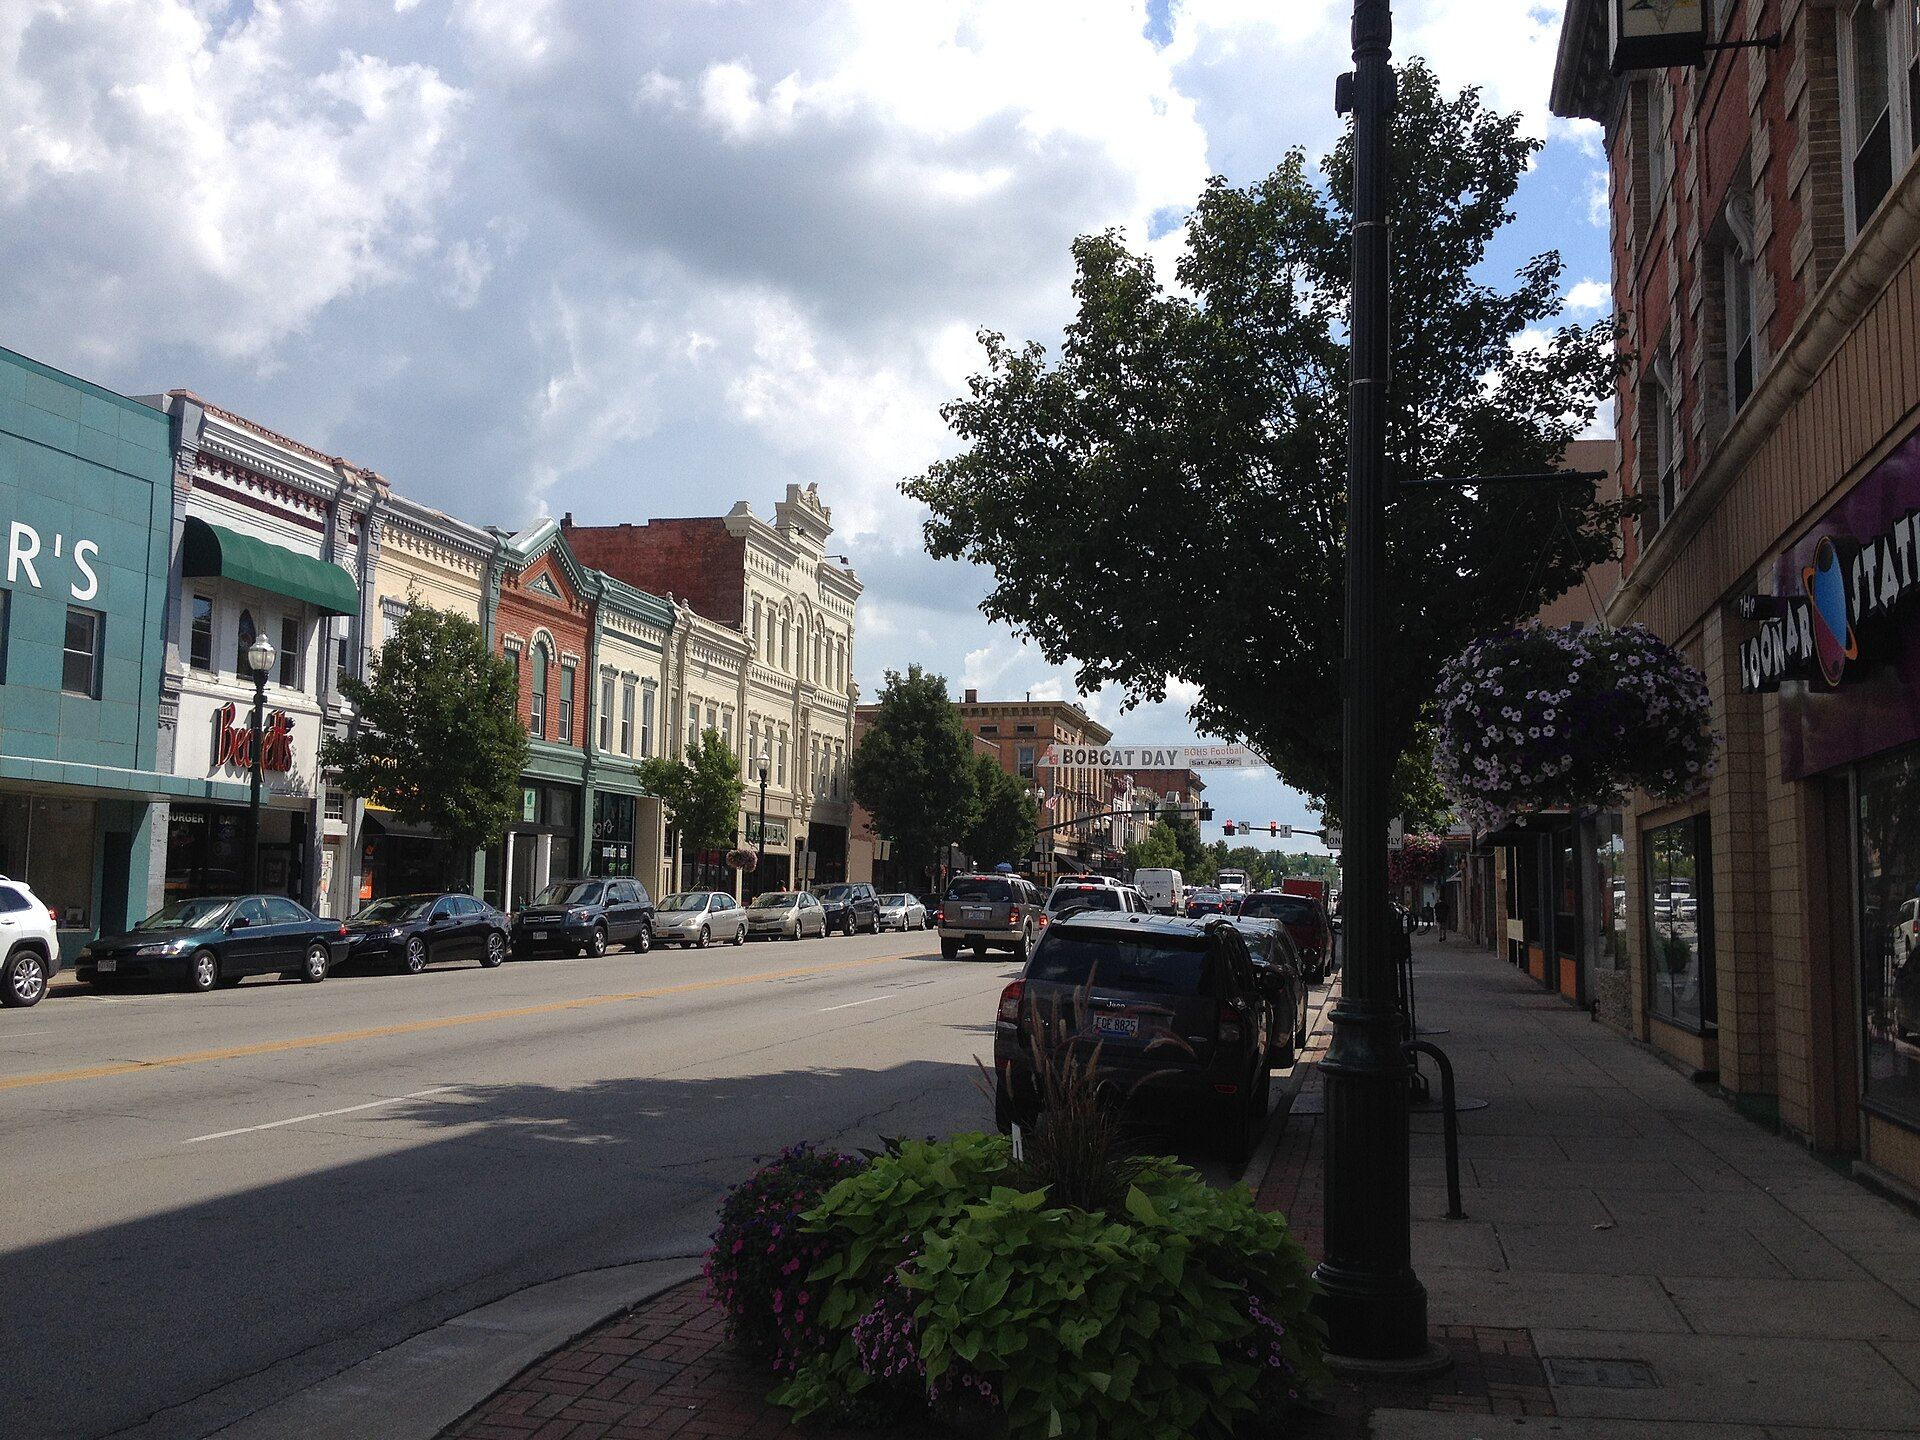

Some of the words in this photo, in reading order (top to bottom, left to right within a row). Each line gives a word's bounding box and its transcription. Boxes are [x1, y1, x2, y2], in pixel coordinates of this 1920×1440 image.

[7, 521, 98, 601] R'S
[1740, 600, 1812, 690] LOONAR
[1063, 749, 1135, 766] BOBCAT
[1142, 750, 1178, 766] DAY
[1184, 748, 1208, 756] BGHS
[1210, 746, 1244, 756] Football
[1329, 837, 1341, 845] ON
